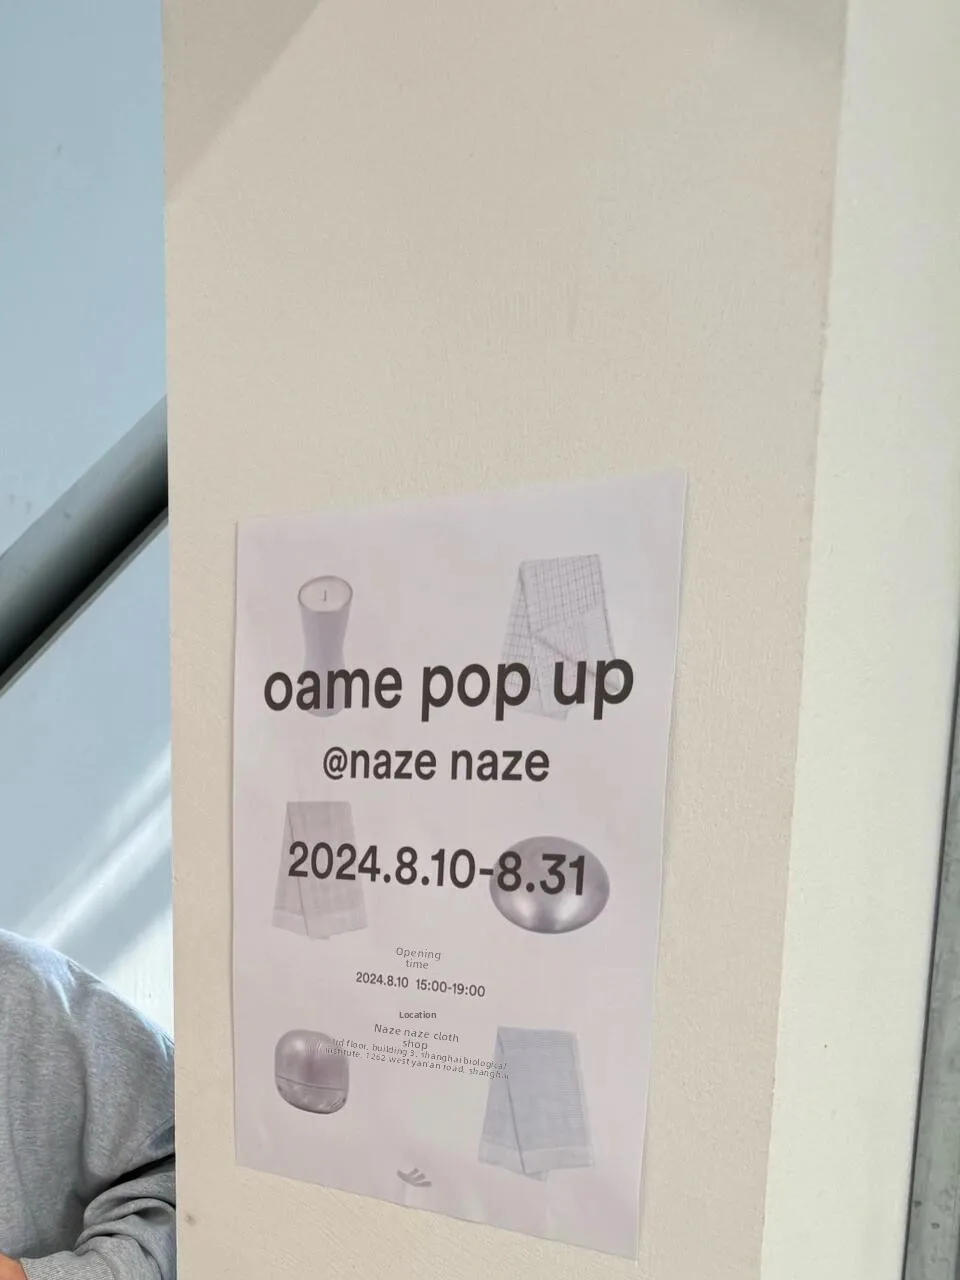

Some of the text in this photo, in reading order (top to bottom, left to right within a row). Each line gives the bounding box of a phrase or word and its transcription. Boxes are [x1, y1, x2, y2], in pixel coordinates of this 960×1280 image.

[264, 658, 634, 722] oame pop up
[323, 746, 550, 781] @naze naze
[288, 840, 586, 895] 2024.8.10-8.31
[396, 946, 441, 961] Opening
[405, 958, 429, 969] time
[356, 971, 486, 997] 2024.8.10 15:00-19:00
[399, 1011, 437, 1019] Location
[374, 1023, 459, 1042] Naze naze cloth
[372, 1043, 408, 1057] building
[402, 1039, 428, 1050] shop
